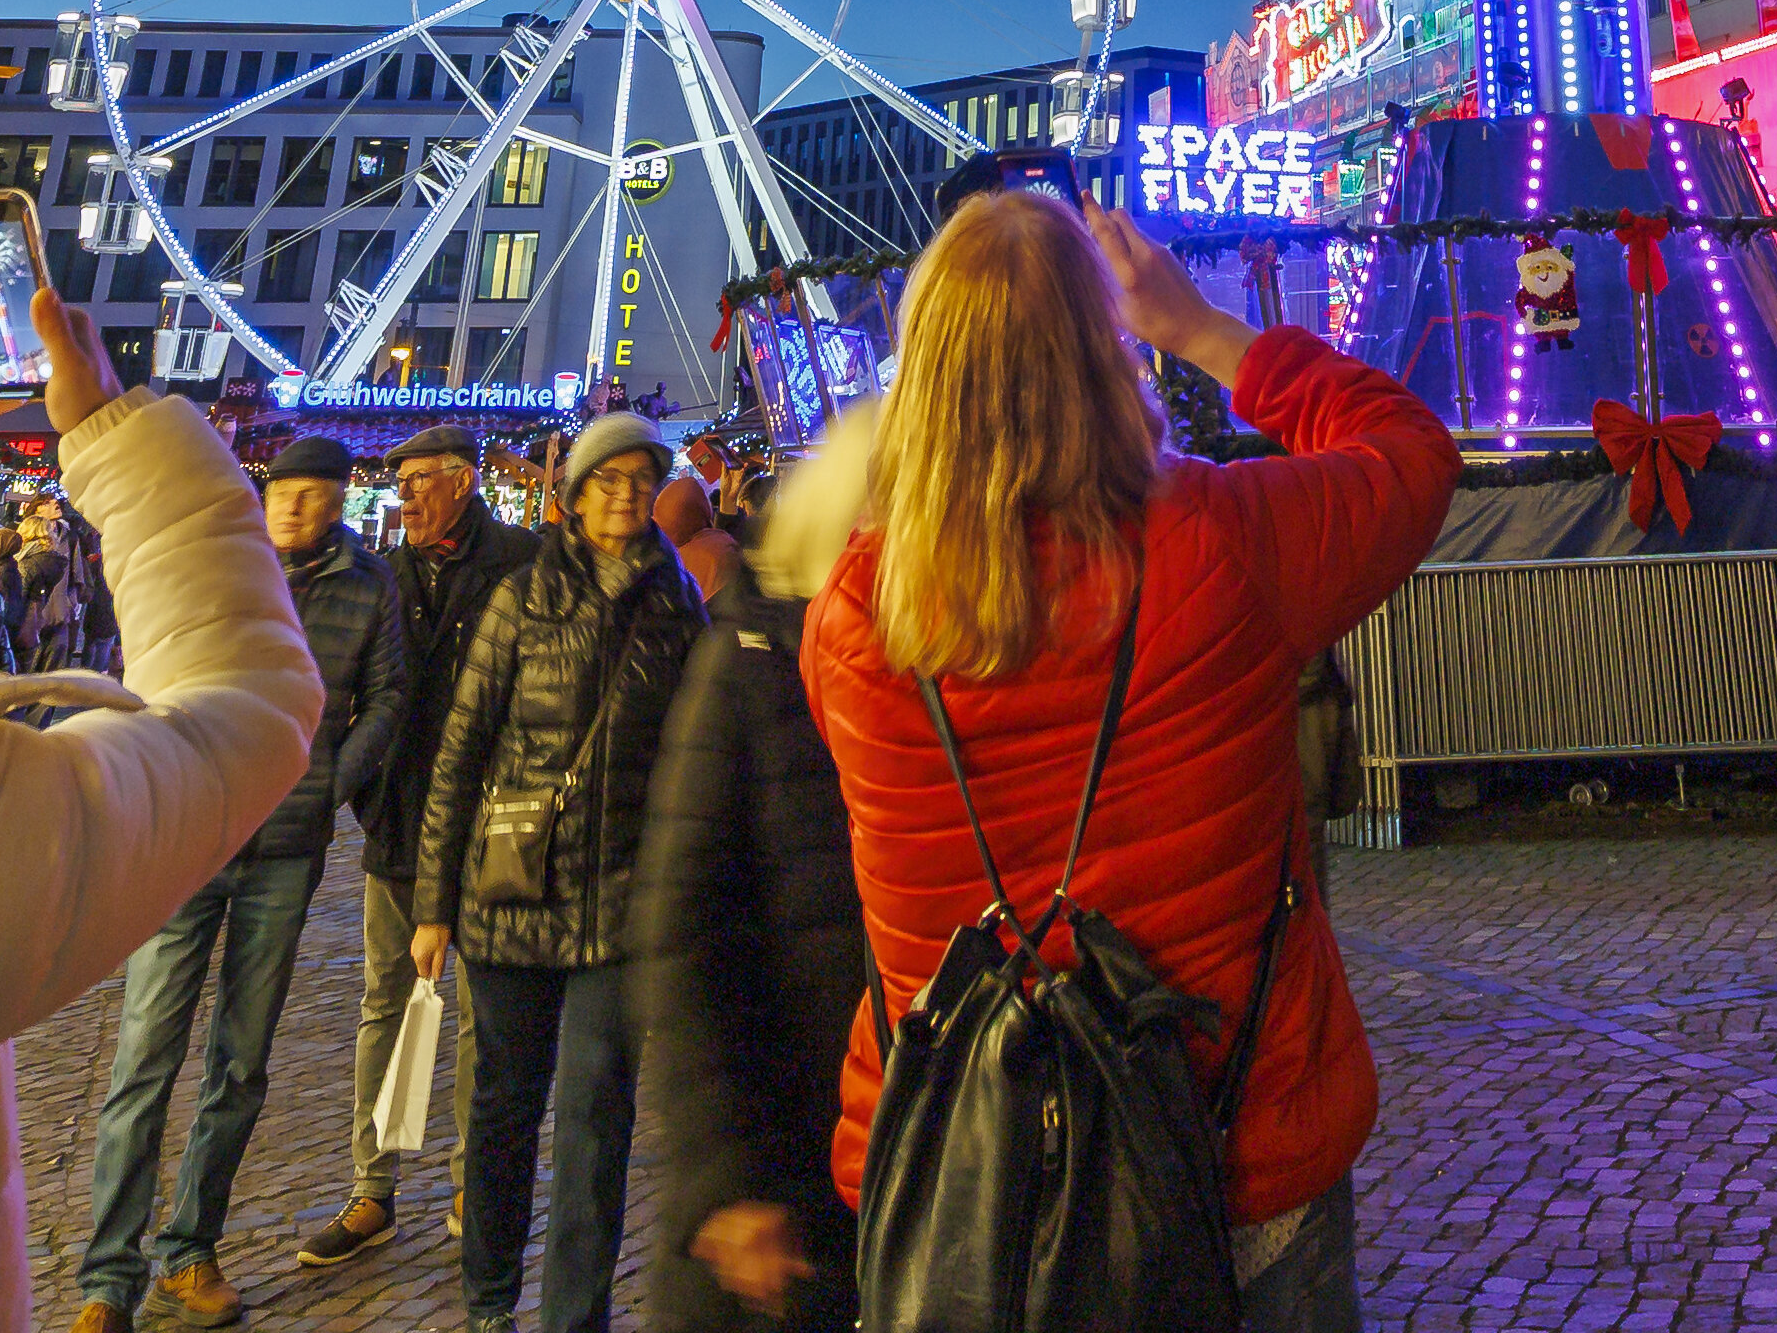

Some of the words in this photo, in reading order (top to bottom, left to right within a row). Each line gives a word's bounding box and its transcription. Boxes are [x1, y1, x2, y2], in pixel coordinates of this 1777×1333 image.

[1138, 124, 1316, 174] SPACE
[619, 157, 668, 181] B&B
[625, 179, 659, 190] HOTELS
[1141, 168, 1311, 217] FLYER
[615, 234, 646, 384] HOTE
[302, 380, 555, 409] Glühweinschänke
